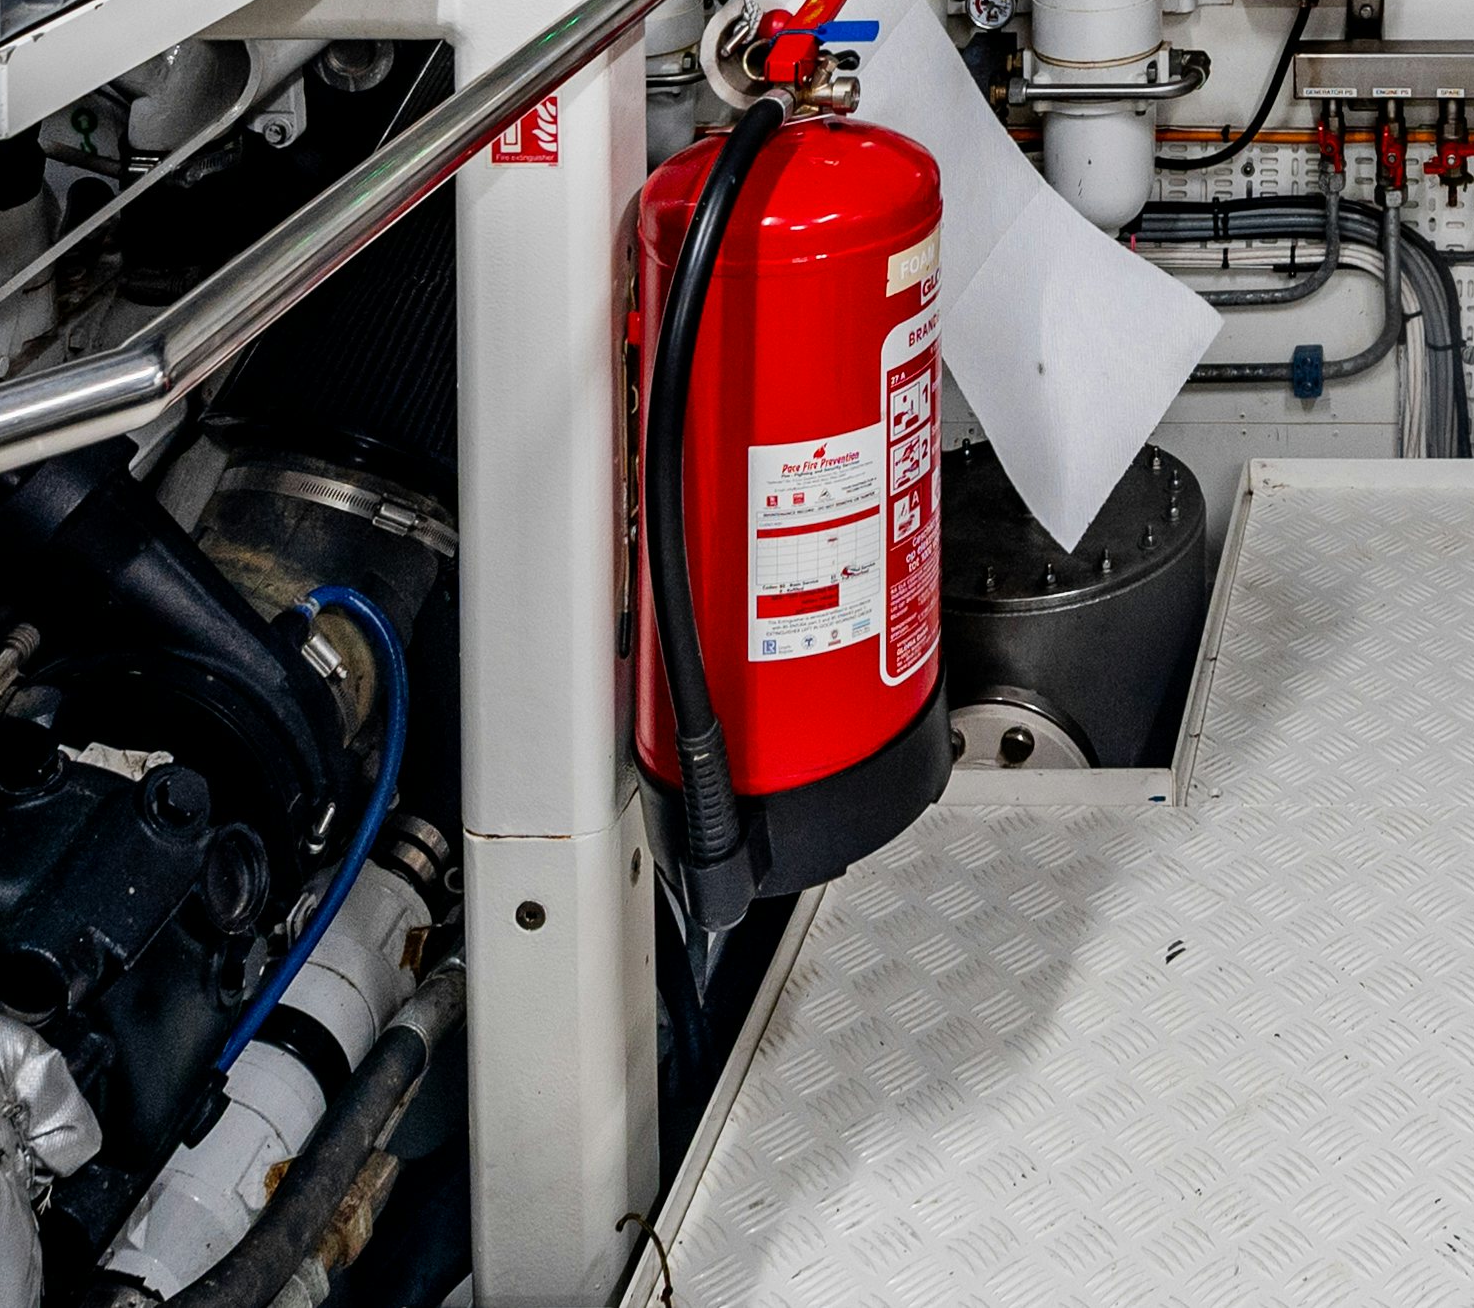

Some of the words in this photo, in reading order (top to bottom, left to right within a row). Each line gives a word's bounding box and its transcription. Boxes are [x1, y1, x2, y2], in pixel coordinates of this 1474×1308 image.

[900, 242, 935, 280] FOAM
[782, 463, 801, 474] Pace
[802, 460, 818, 472] Fire
[820, 450, 860, 468] Prevention
[911, 490, 920, 508] A
